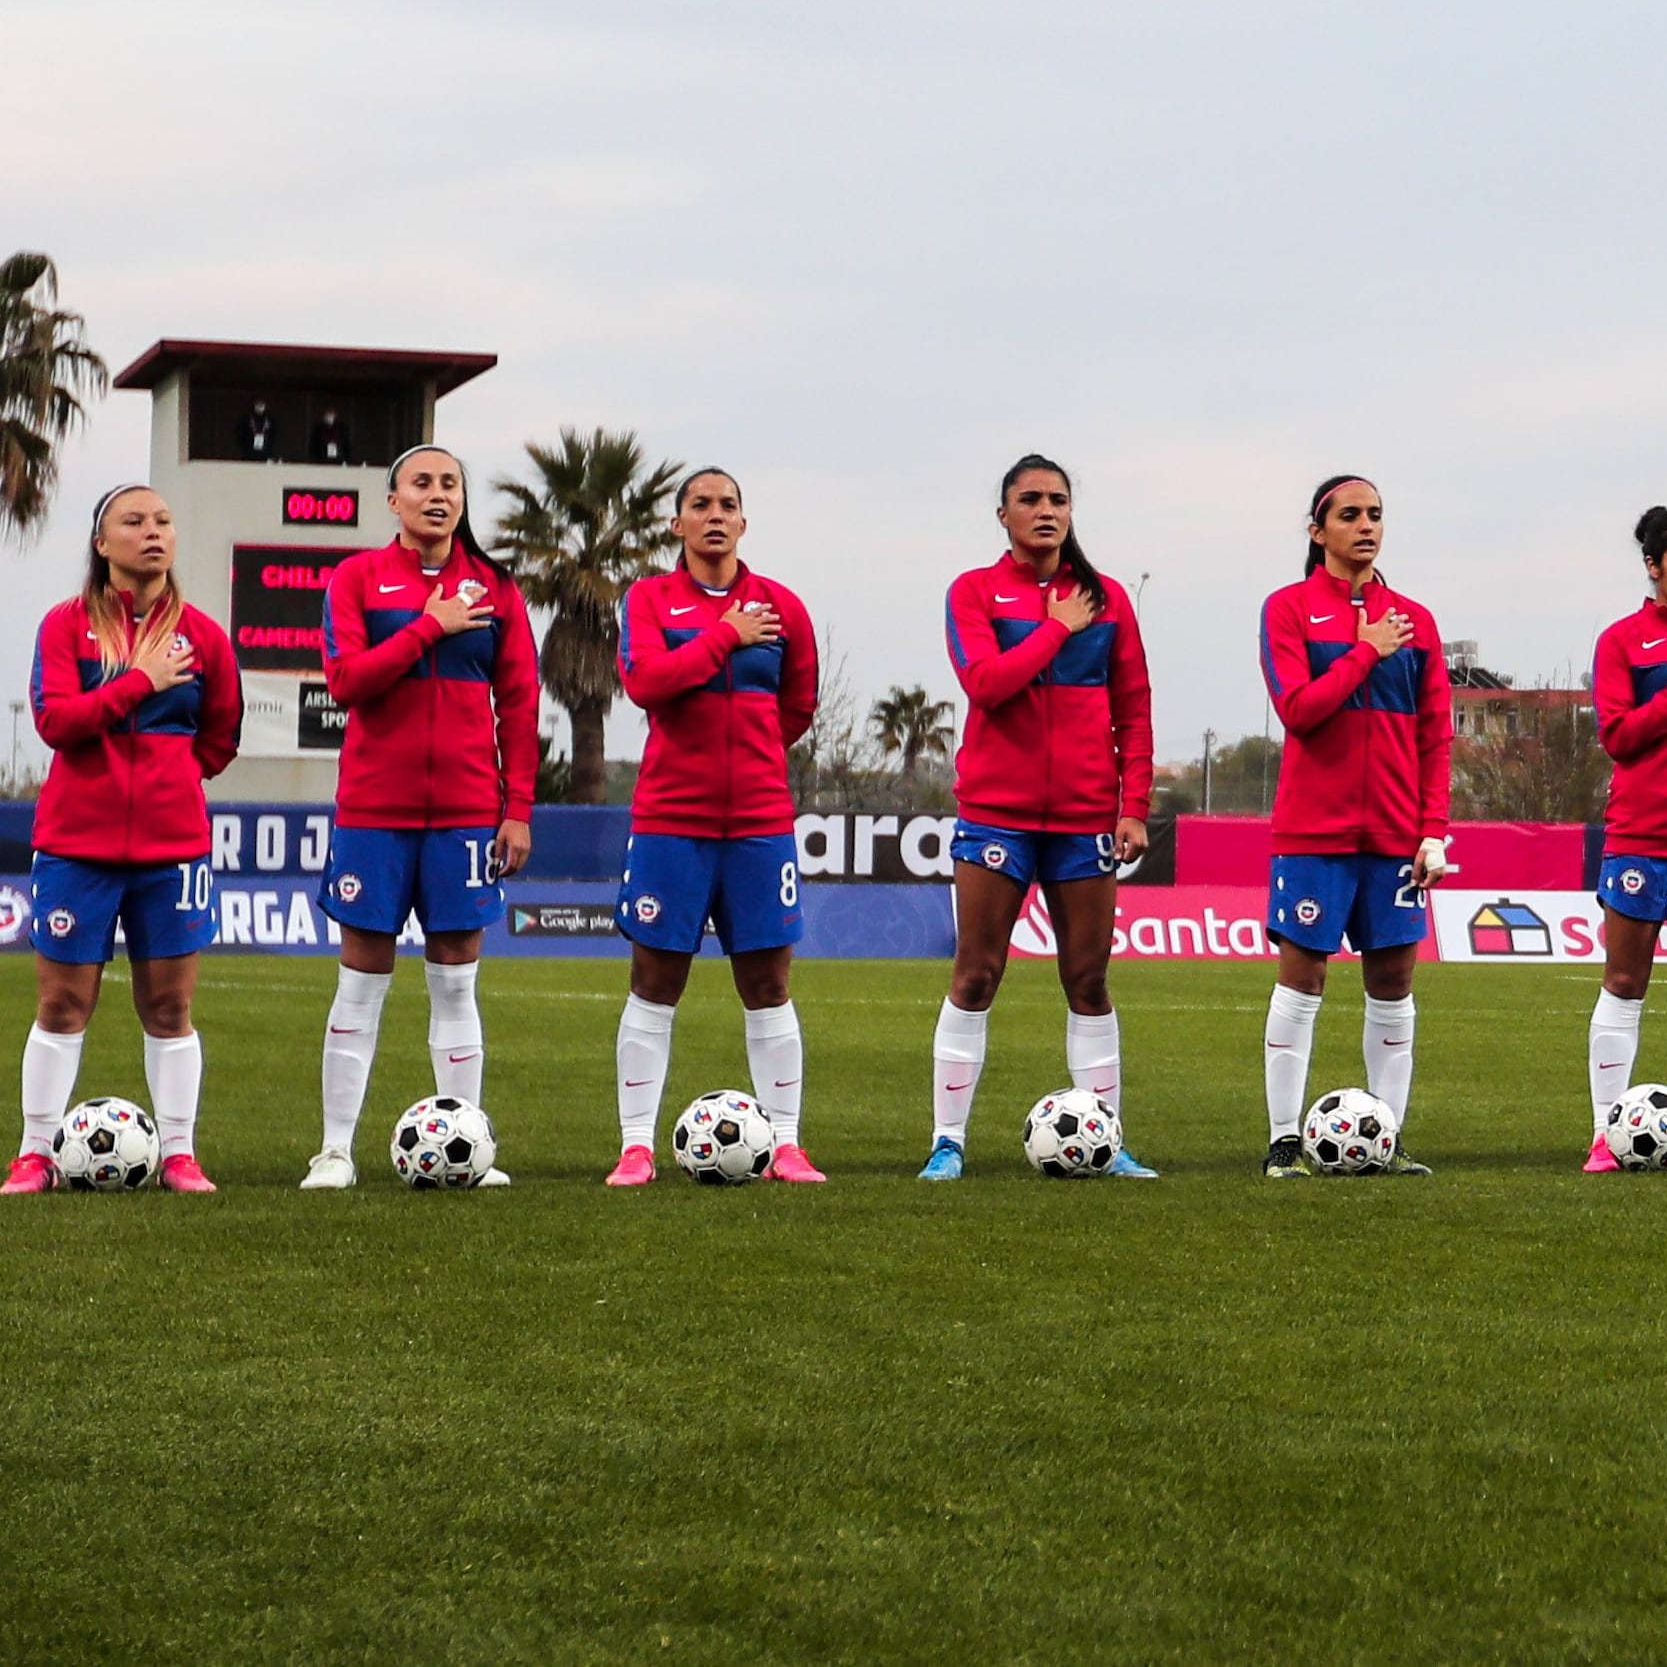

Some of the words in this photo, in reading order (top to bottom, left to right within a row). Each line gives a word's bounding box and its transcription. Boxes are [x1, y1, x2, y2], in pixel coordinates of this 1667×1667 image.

[287, 493, 354, 521] 00:00
[1096, 833, 1114, 872] 9
[175, 863, 209, 911] 10
[780, 861, 798, 907] 8
[540, 914, 587, 932] Google
